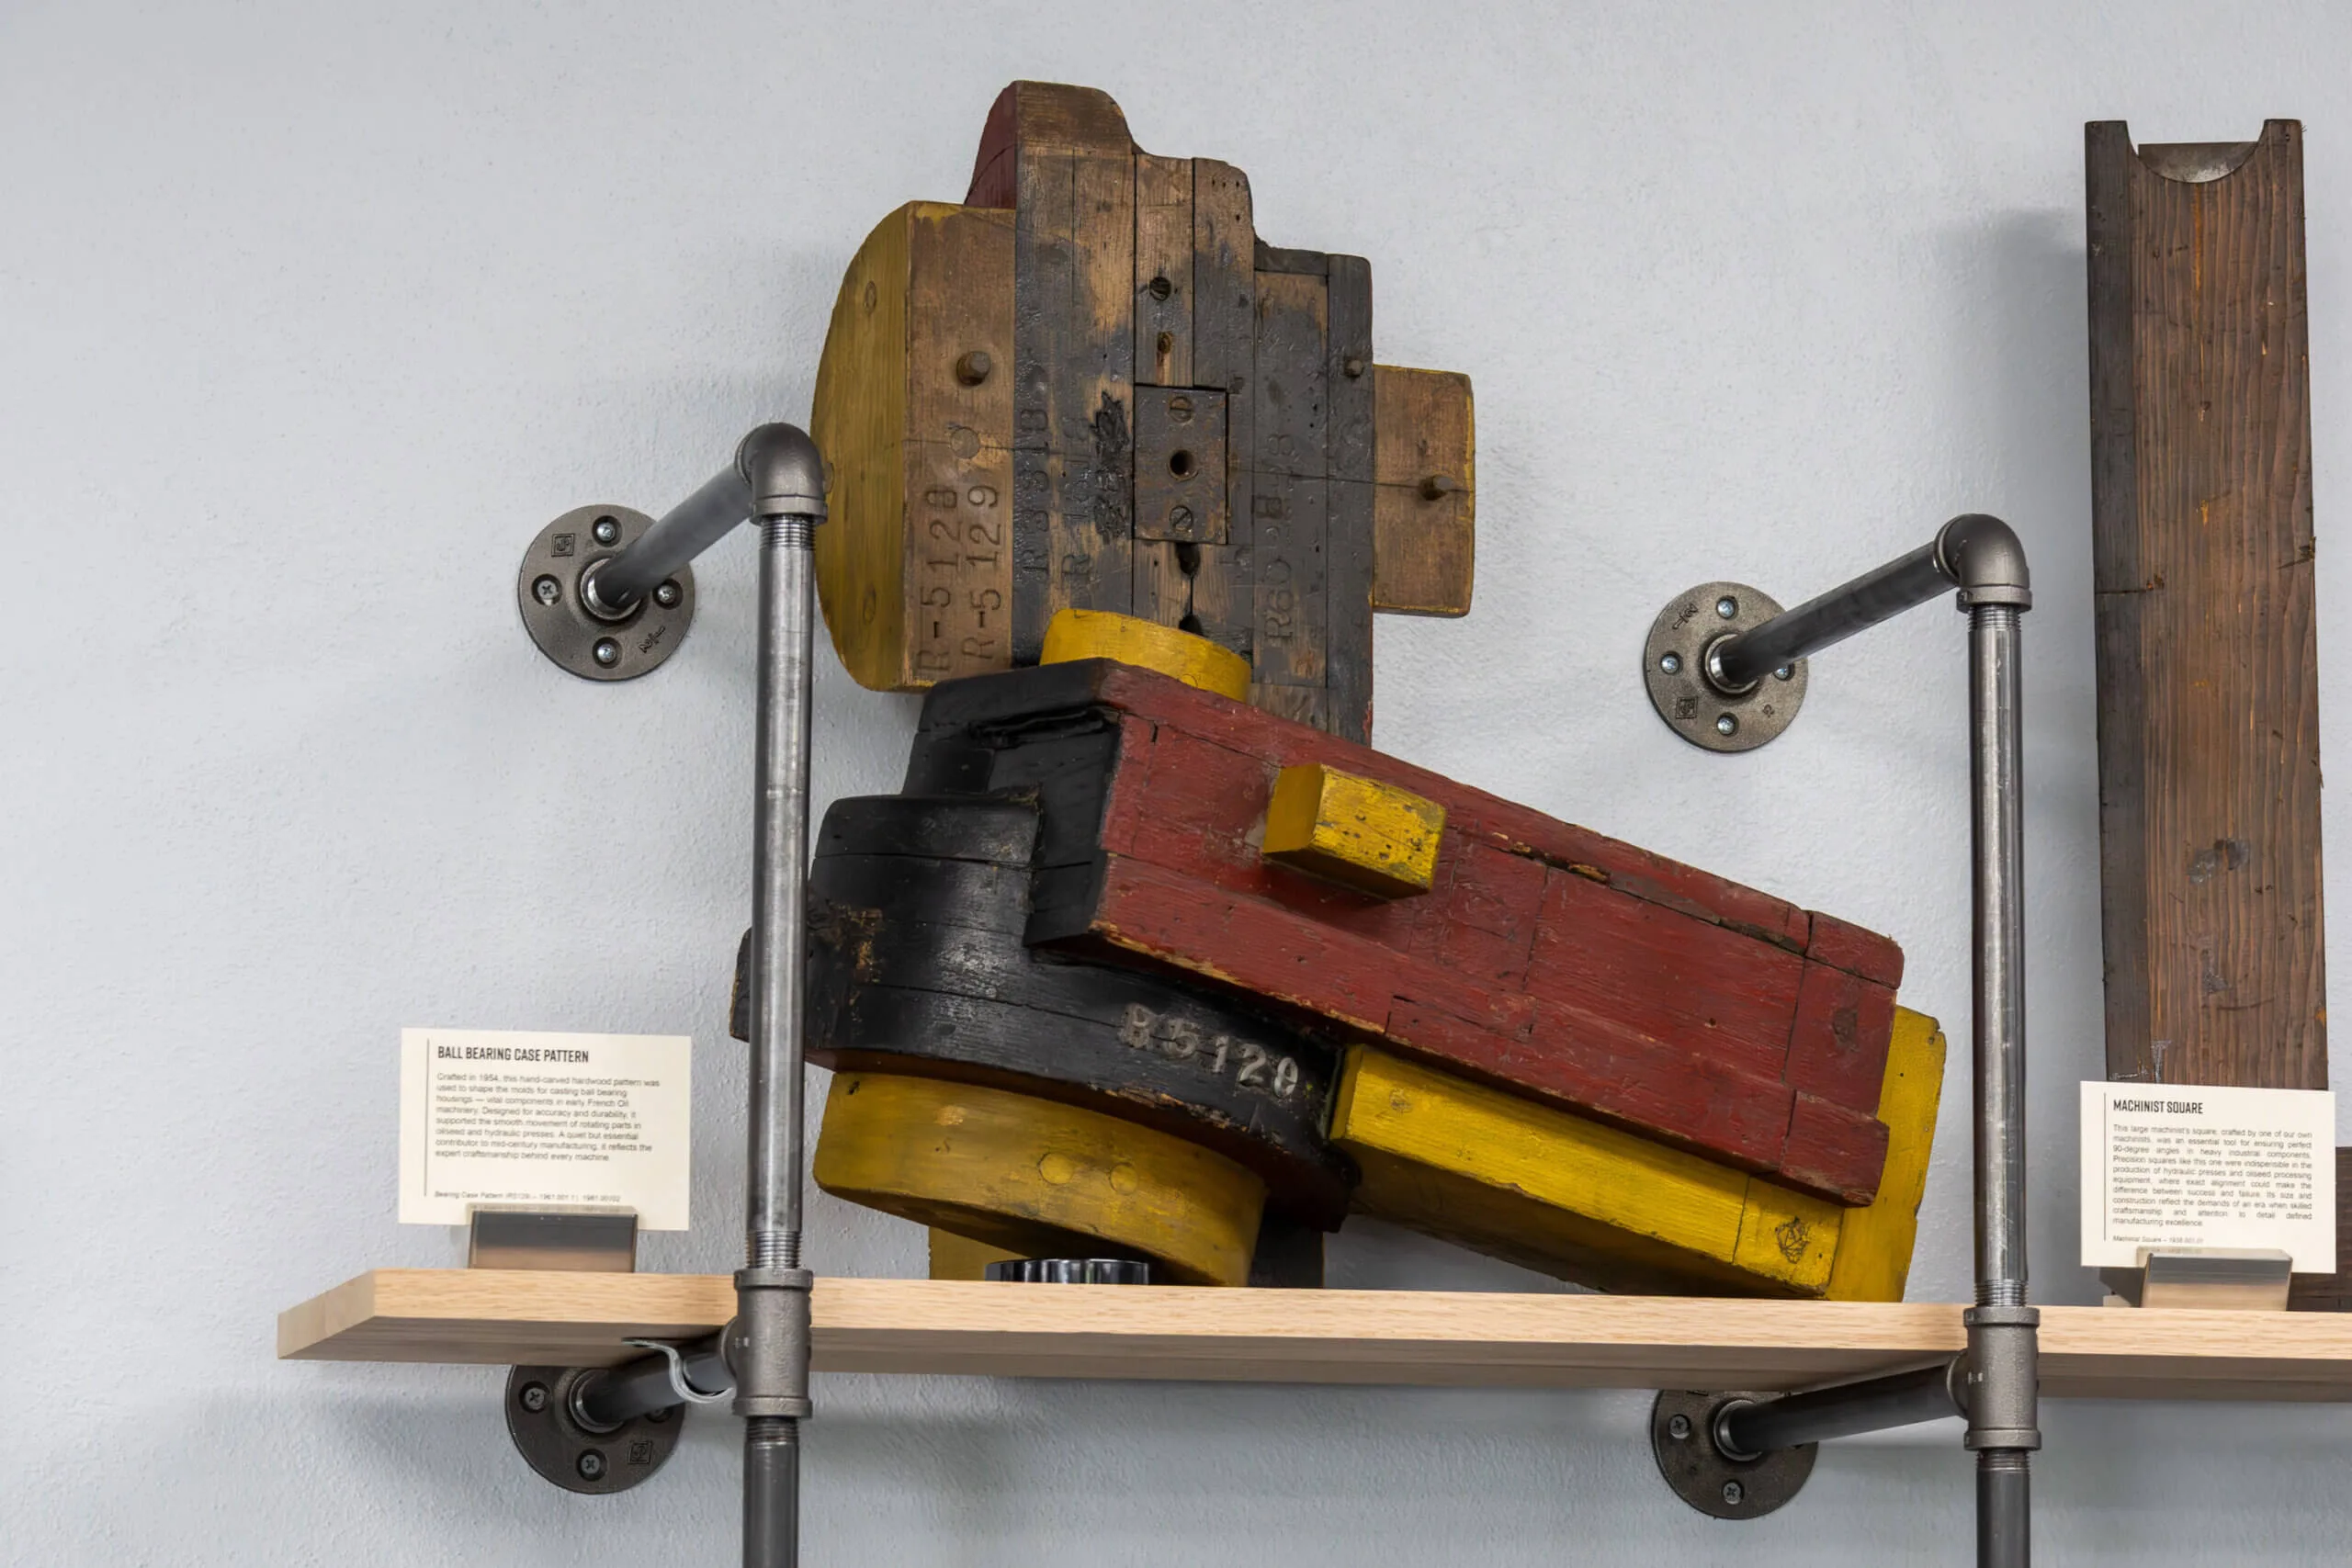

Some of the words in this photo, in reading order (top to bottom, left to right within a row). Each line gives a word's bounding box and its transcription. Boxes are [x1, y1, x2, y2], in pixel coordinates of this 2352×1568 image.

[960, 484, 1001, 660] R-5129
[437, 1046, 464, 1059] BALL
[466, 1047, 512, 1060] BEARING
[514, 1048, 540, 1061] CASE
[544, 1049, 589, 1063] PATTERN
[436, 1073, 467, 1081] Crafted
[503, 1075, 517, 1083] this
[519, 1075, 569, 1084] hand-carved
[571, 1077, 611, 1086] hardwood
[613, 1077, 641, 1088] pattern
[2113, 1100, 2165, 1113] MACHINIST
[2167, 1101, 2203, 1114] SQUARE
